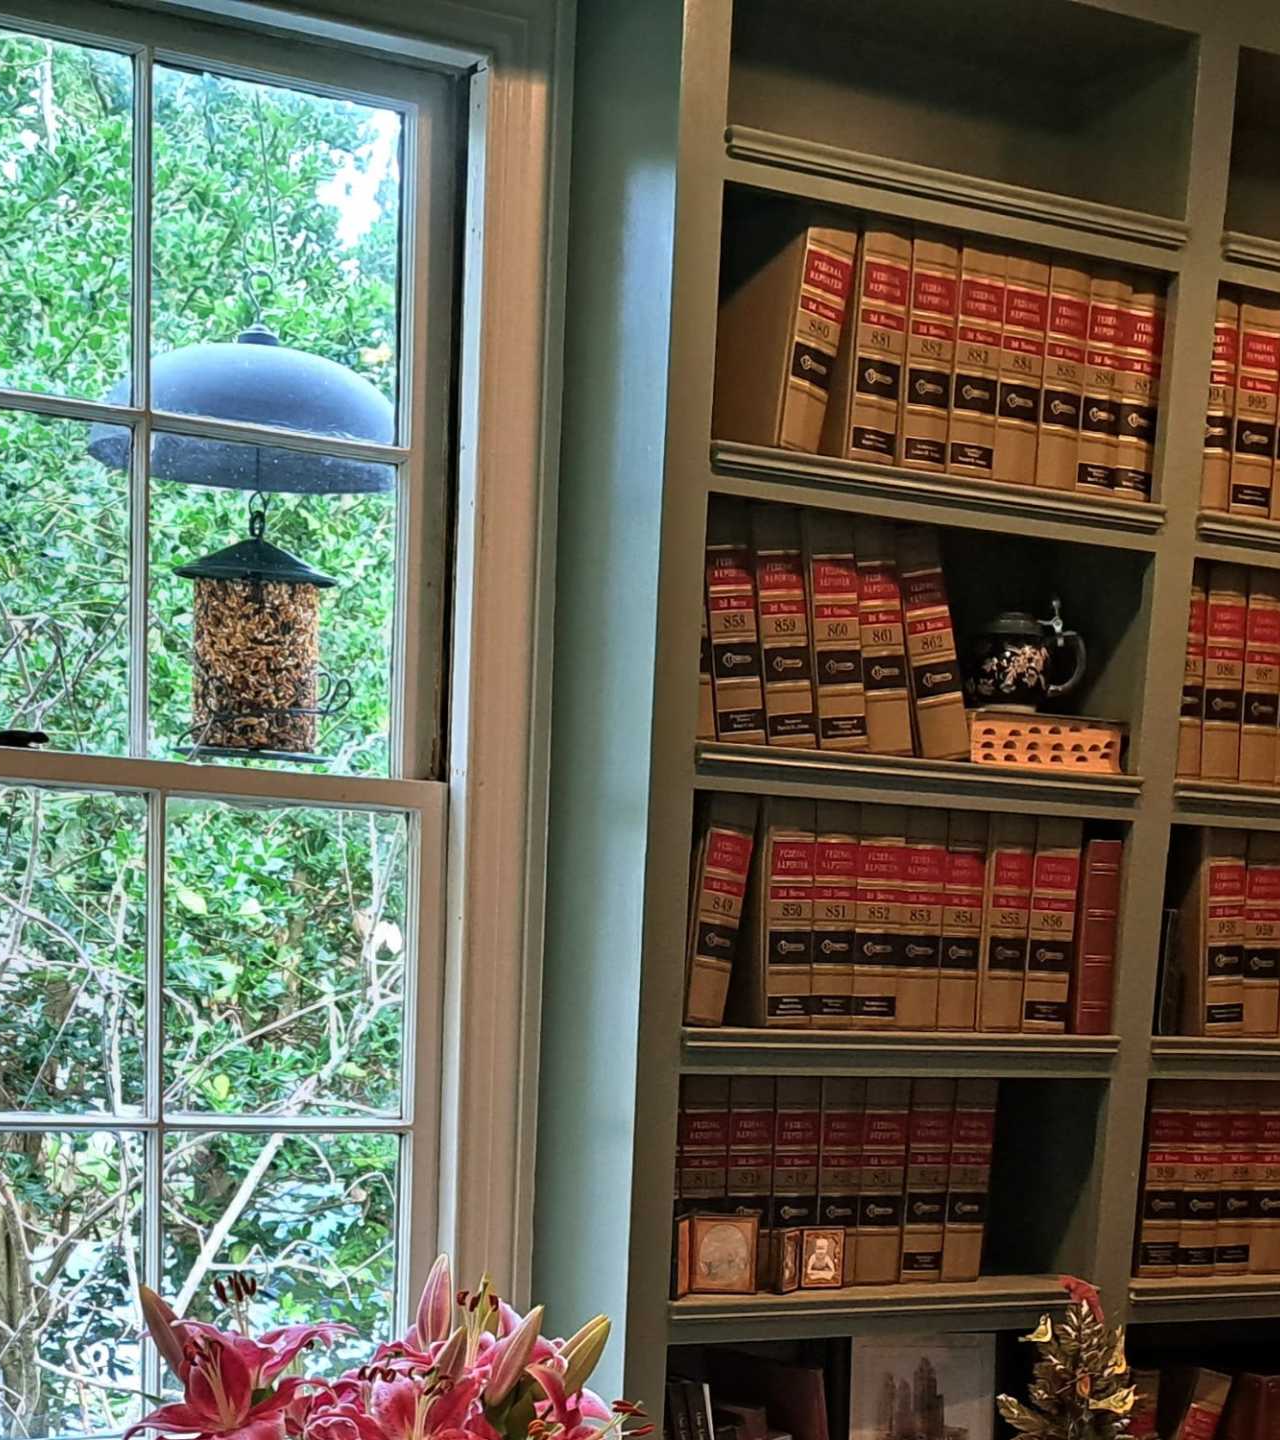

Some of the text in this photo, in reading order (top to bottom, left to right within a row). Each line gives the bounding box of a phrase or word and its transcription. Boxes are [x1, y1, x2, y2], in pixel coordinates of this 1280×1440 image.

[871, 331, 891, 348] 881
[825, 904, 846, 918] 851
[868, 905, 890, 920] 852
[910, 909, 931, 922] 853
